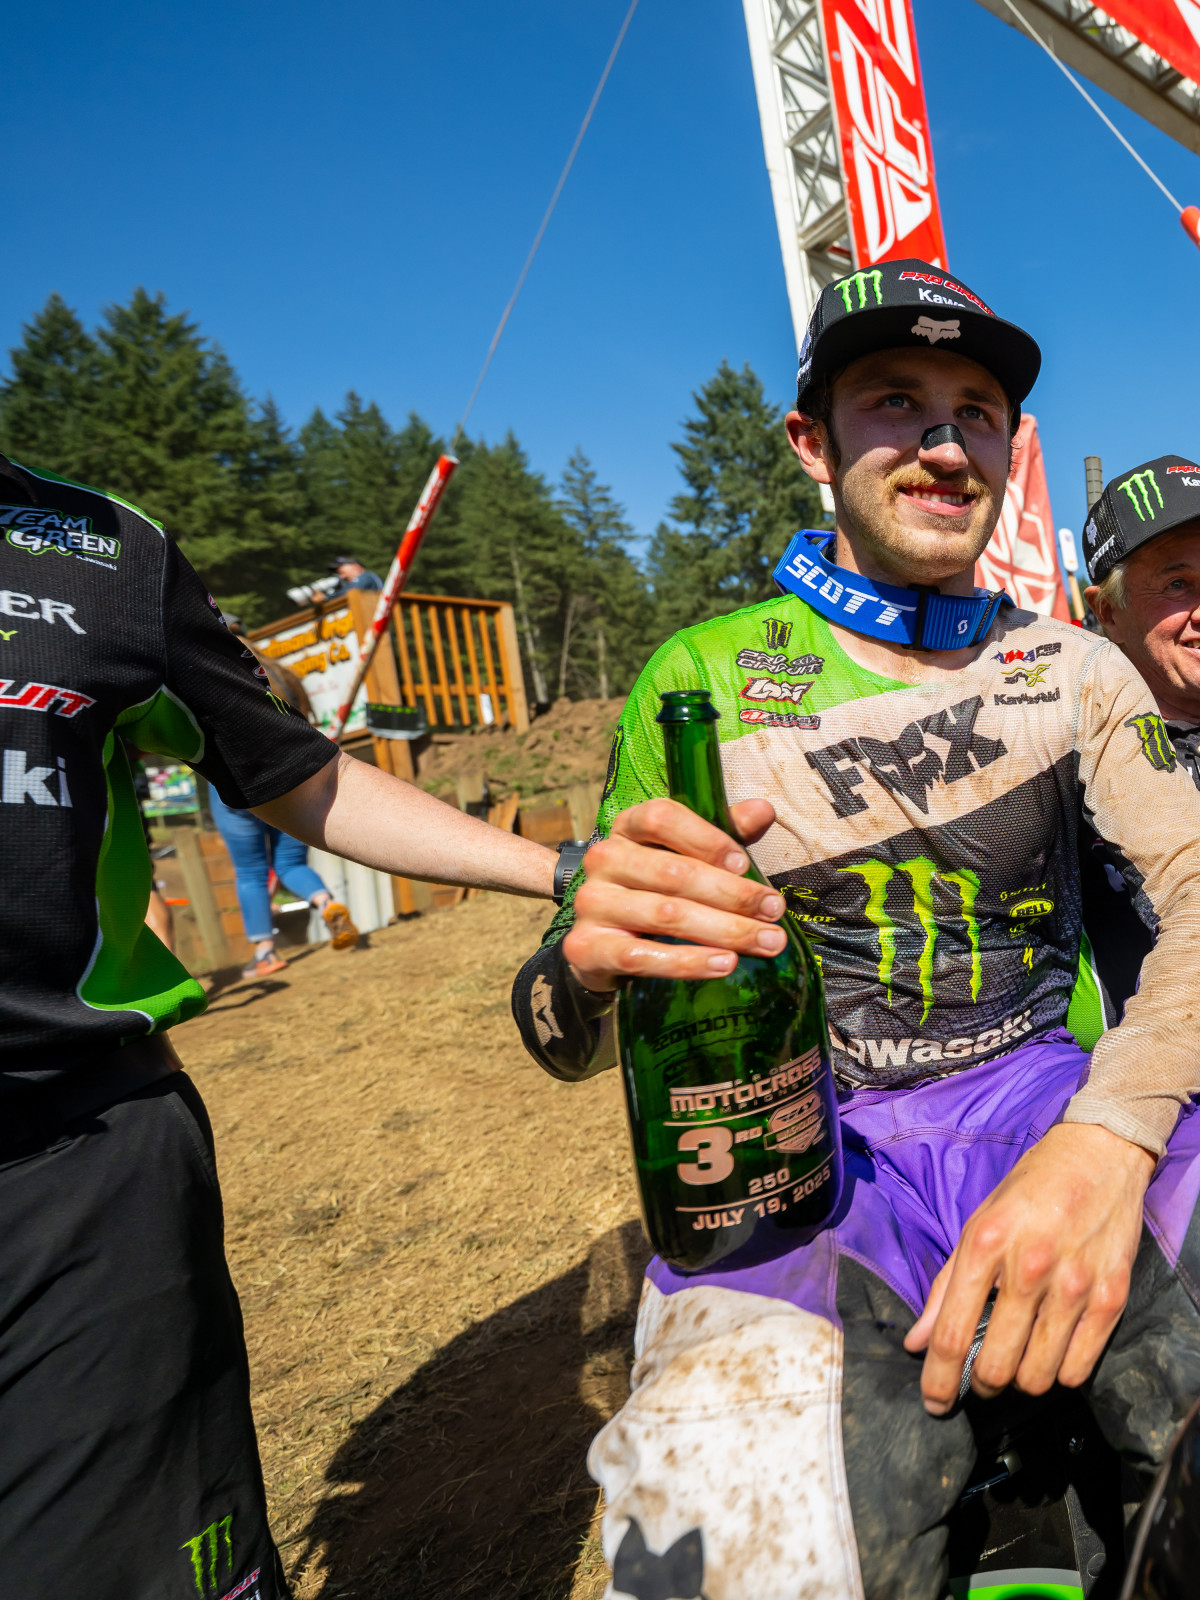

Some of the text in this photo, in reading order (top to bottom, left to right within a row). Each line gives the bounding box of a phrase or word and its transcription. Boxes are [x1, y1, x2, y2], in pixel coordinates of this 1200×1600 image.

[898, 271, 944, 285] PRO
[0, 504, 89, 534] TEAM
[10, 526, 117, 555] GREEN
[784, 552, 918, 627] SCOTT
[1016, 903, 1048, 916] BELL
[669, 1050, 822, 1113] MOTOCROSS
[748, 1167, 791, 1195] 250
[692, 1164, 831, 1231] JULY 19, 2025
